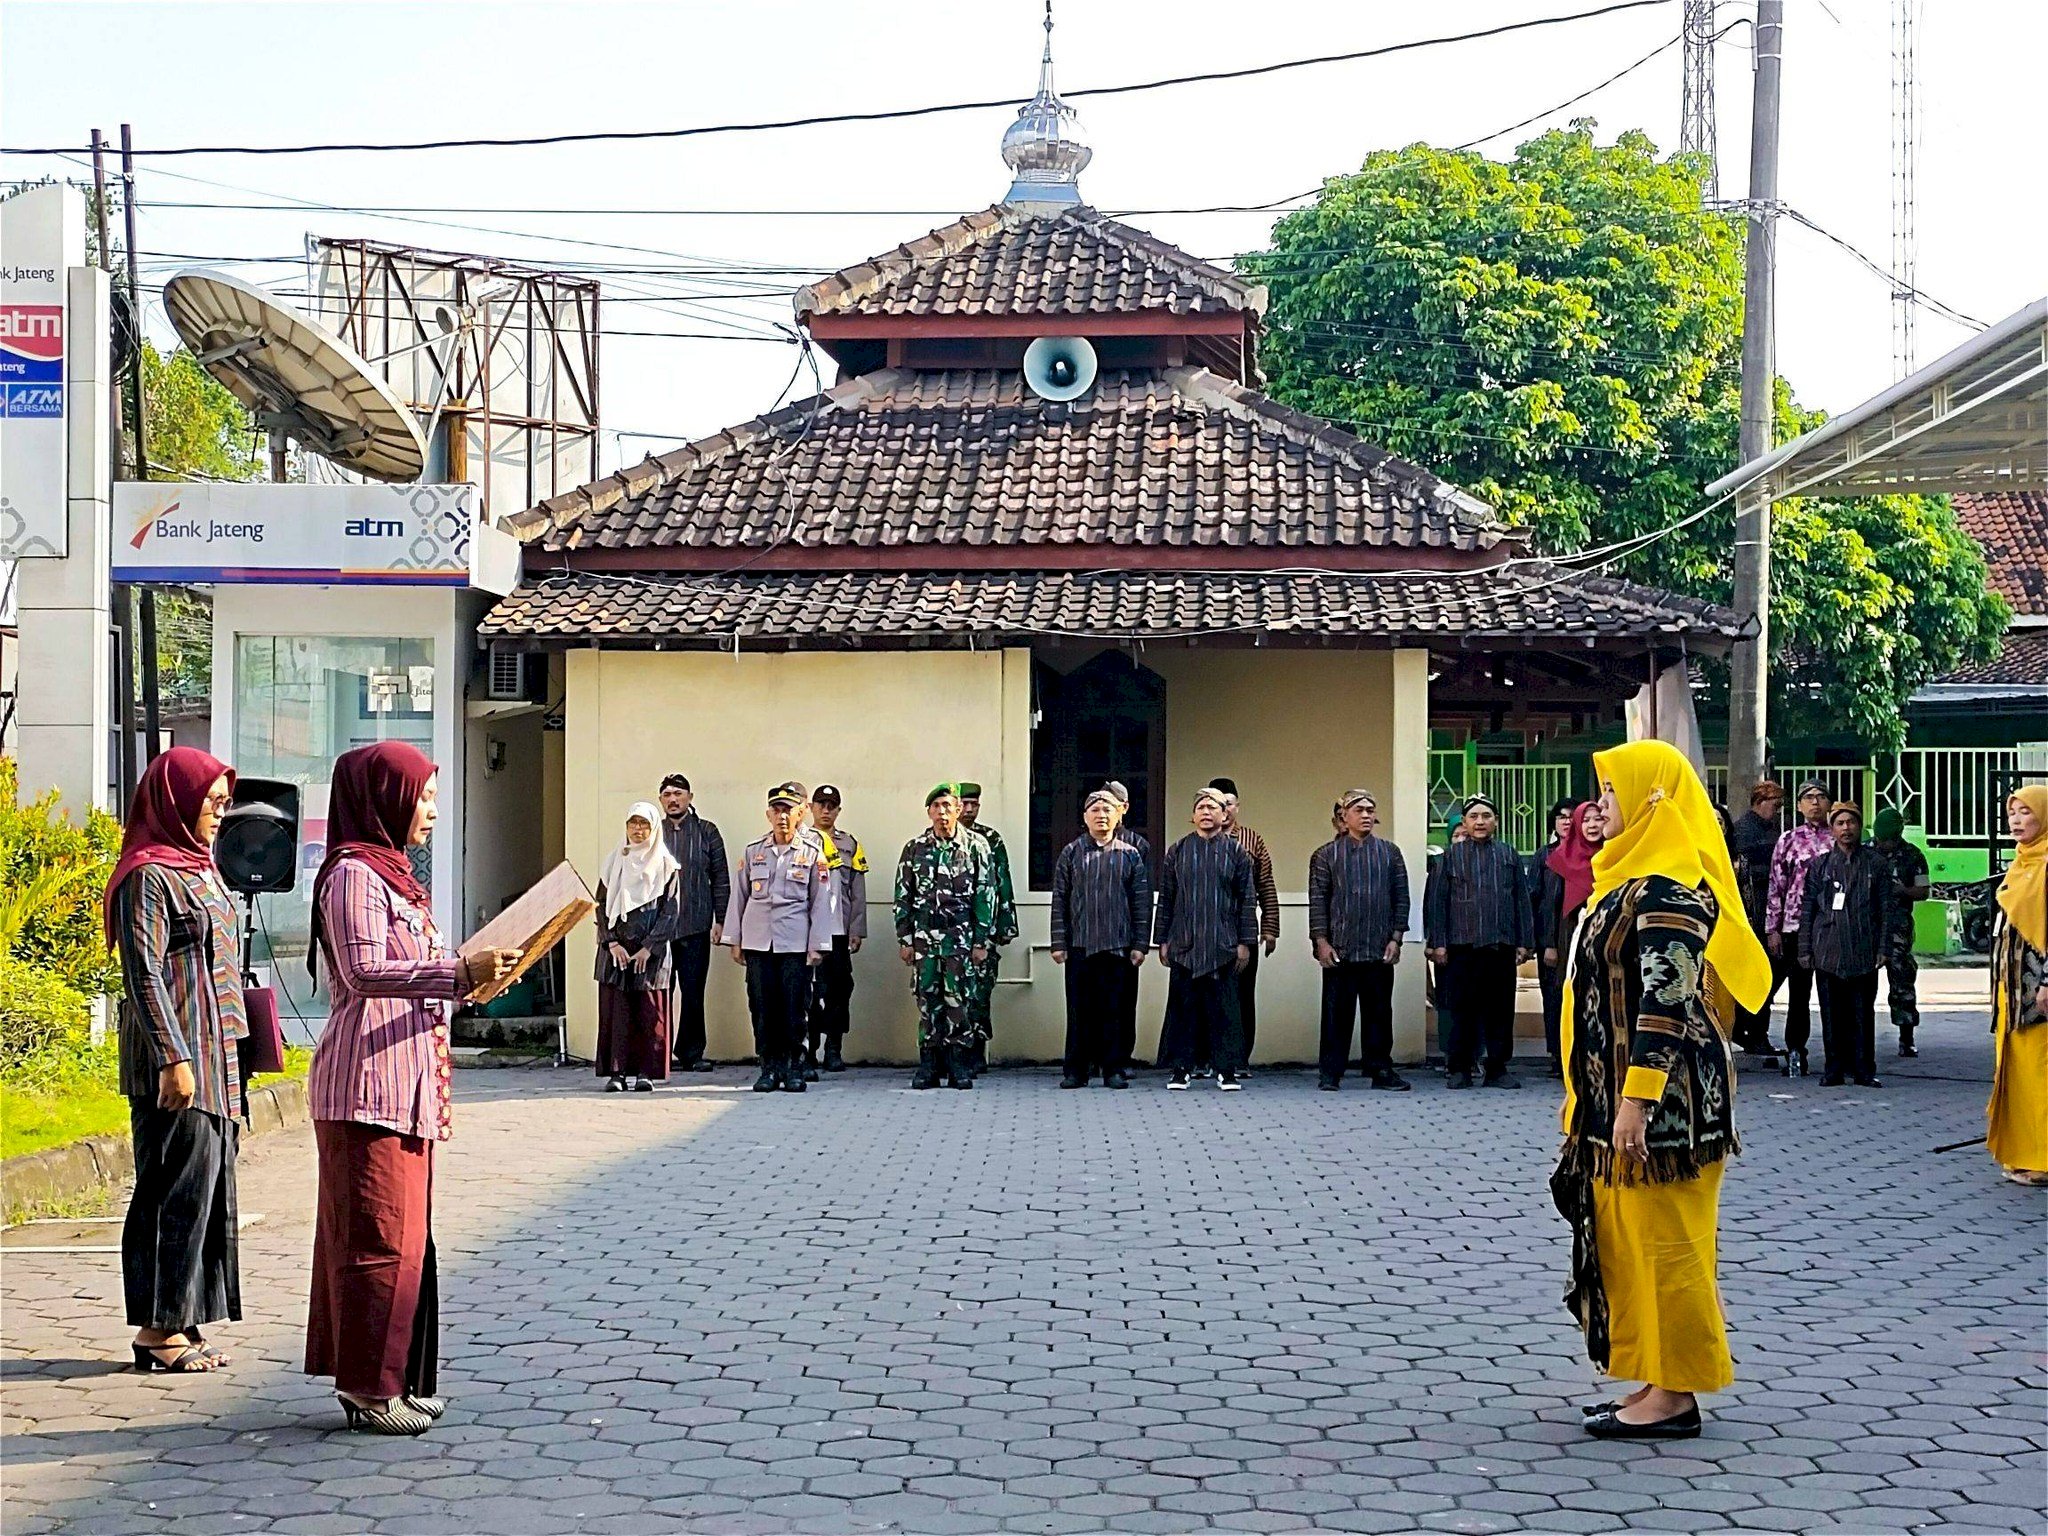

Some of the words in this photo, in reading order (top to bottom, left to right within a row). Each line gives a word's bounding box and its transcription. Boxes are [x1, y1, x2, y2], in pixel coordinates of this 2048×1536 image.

[13, 266, 55, 283] Jateng
[10, 389, 62, 405] ATM
[10, 404, 62, 413] BERSAMA
[156, 519, 202, 538] Bank
[206, 519, 264, 542] Jateng
[345, 517, 404, 537] atm
